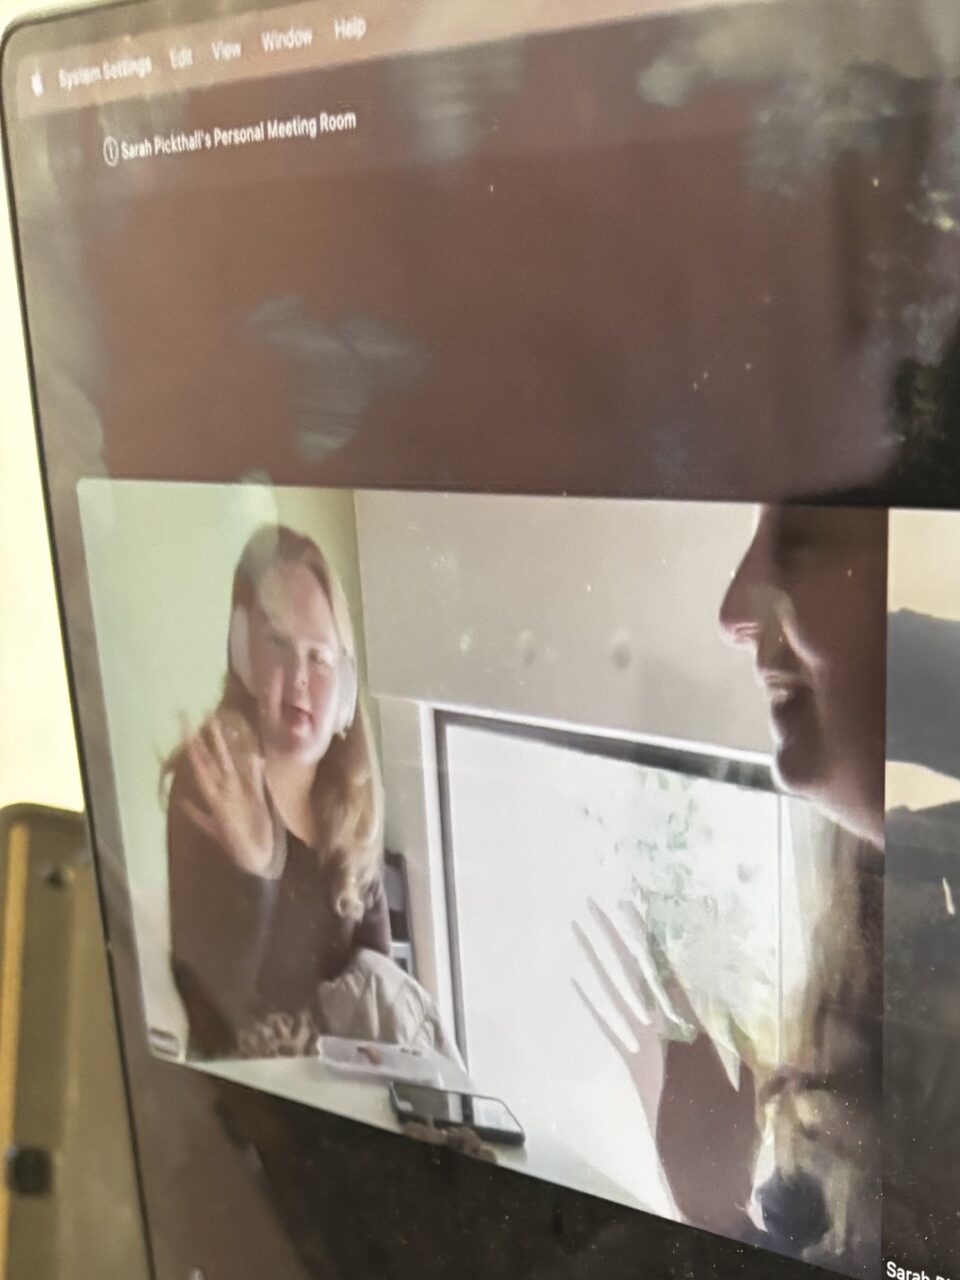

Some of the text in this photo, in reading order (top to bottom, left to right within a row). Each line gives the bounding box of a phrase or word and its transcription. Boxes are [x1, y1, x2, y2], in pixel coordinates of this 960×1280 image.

[169, 46, 193, 70] Edit
[211, 41, 241, 61] View
[261, 27, 313, 52] Window
[334, 16, 366, 41] Help
[121, 111, 357, 160] Sarah Pickthall's Personal Meeting Room
